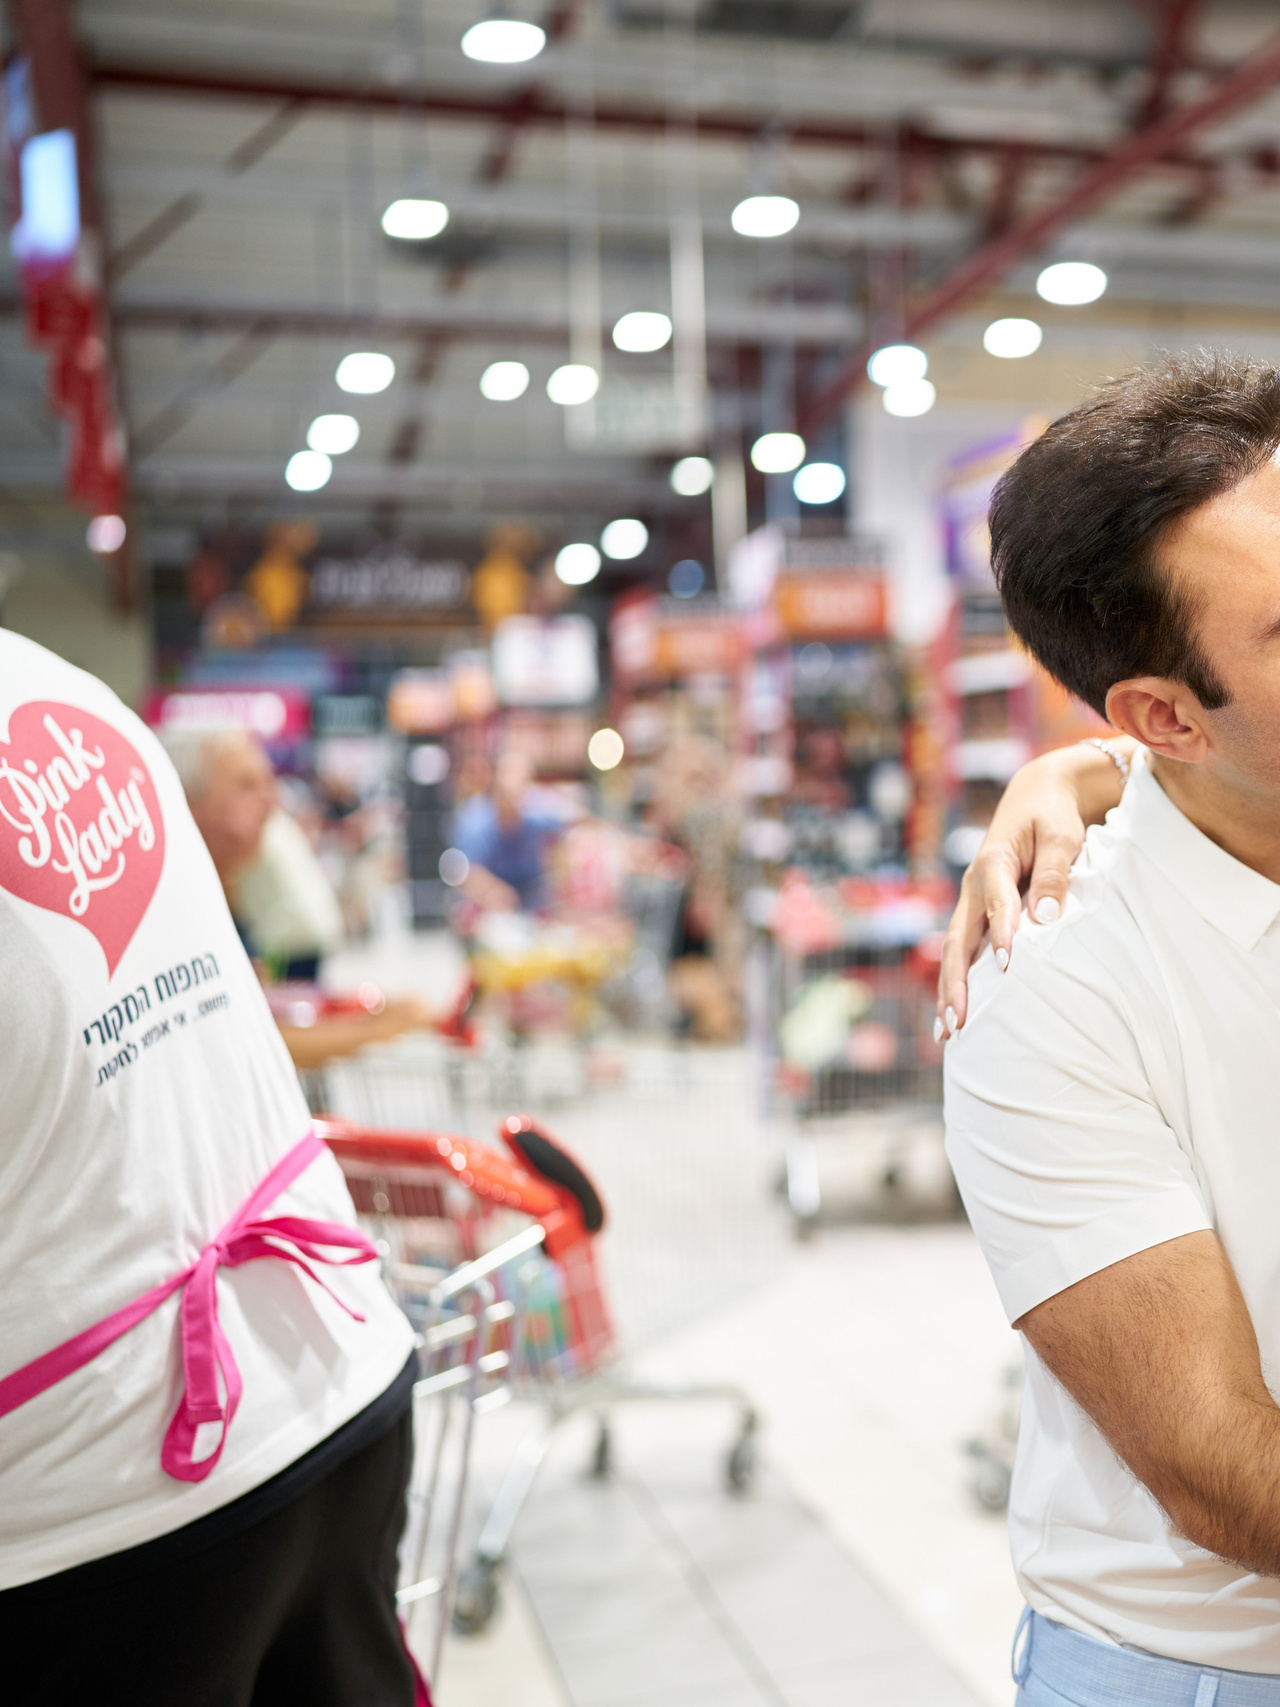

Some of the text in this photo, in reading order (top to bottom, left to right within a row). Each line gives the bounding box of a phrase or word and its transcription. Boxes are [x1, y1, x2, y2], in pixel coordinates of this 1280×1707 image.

[0, 713, 105, 868] Pink
[52, 773, 155, 916] Lady
[83, 953, 220, 1046] התפוח המקורי
